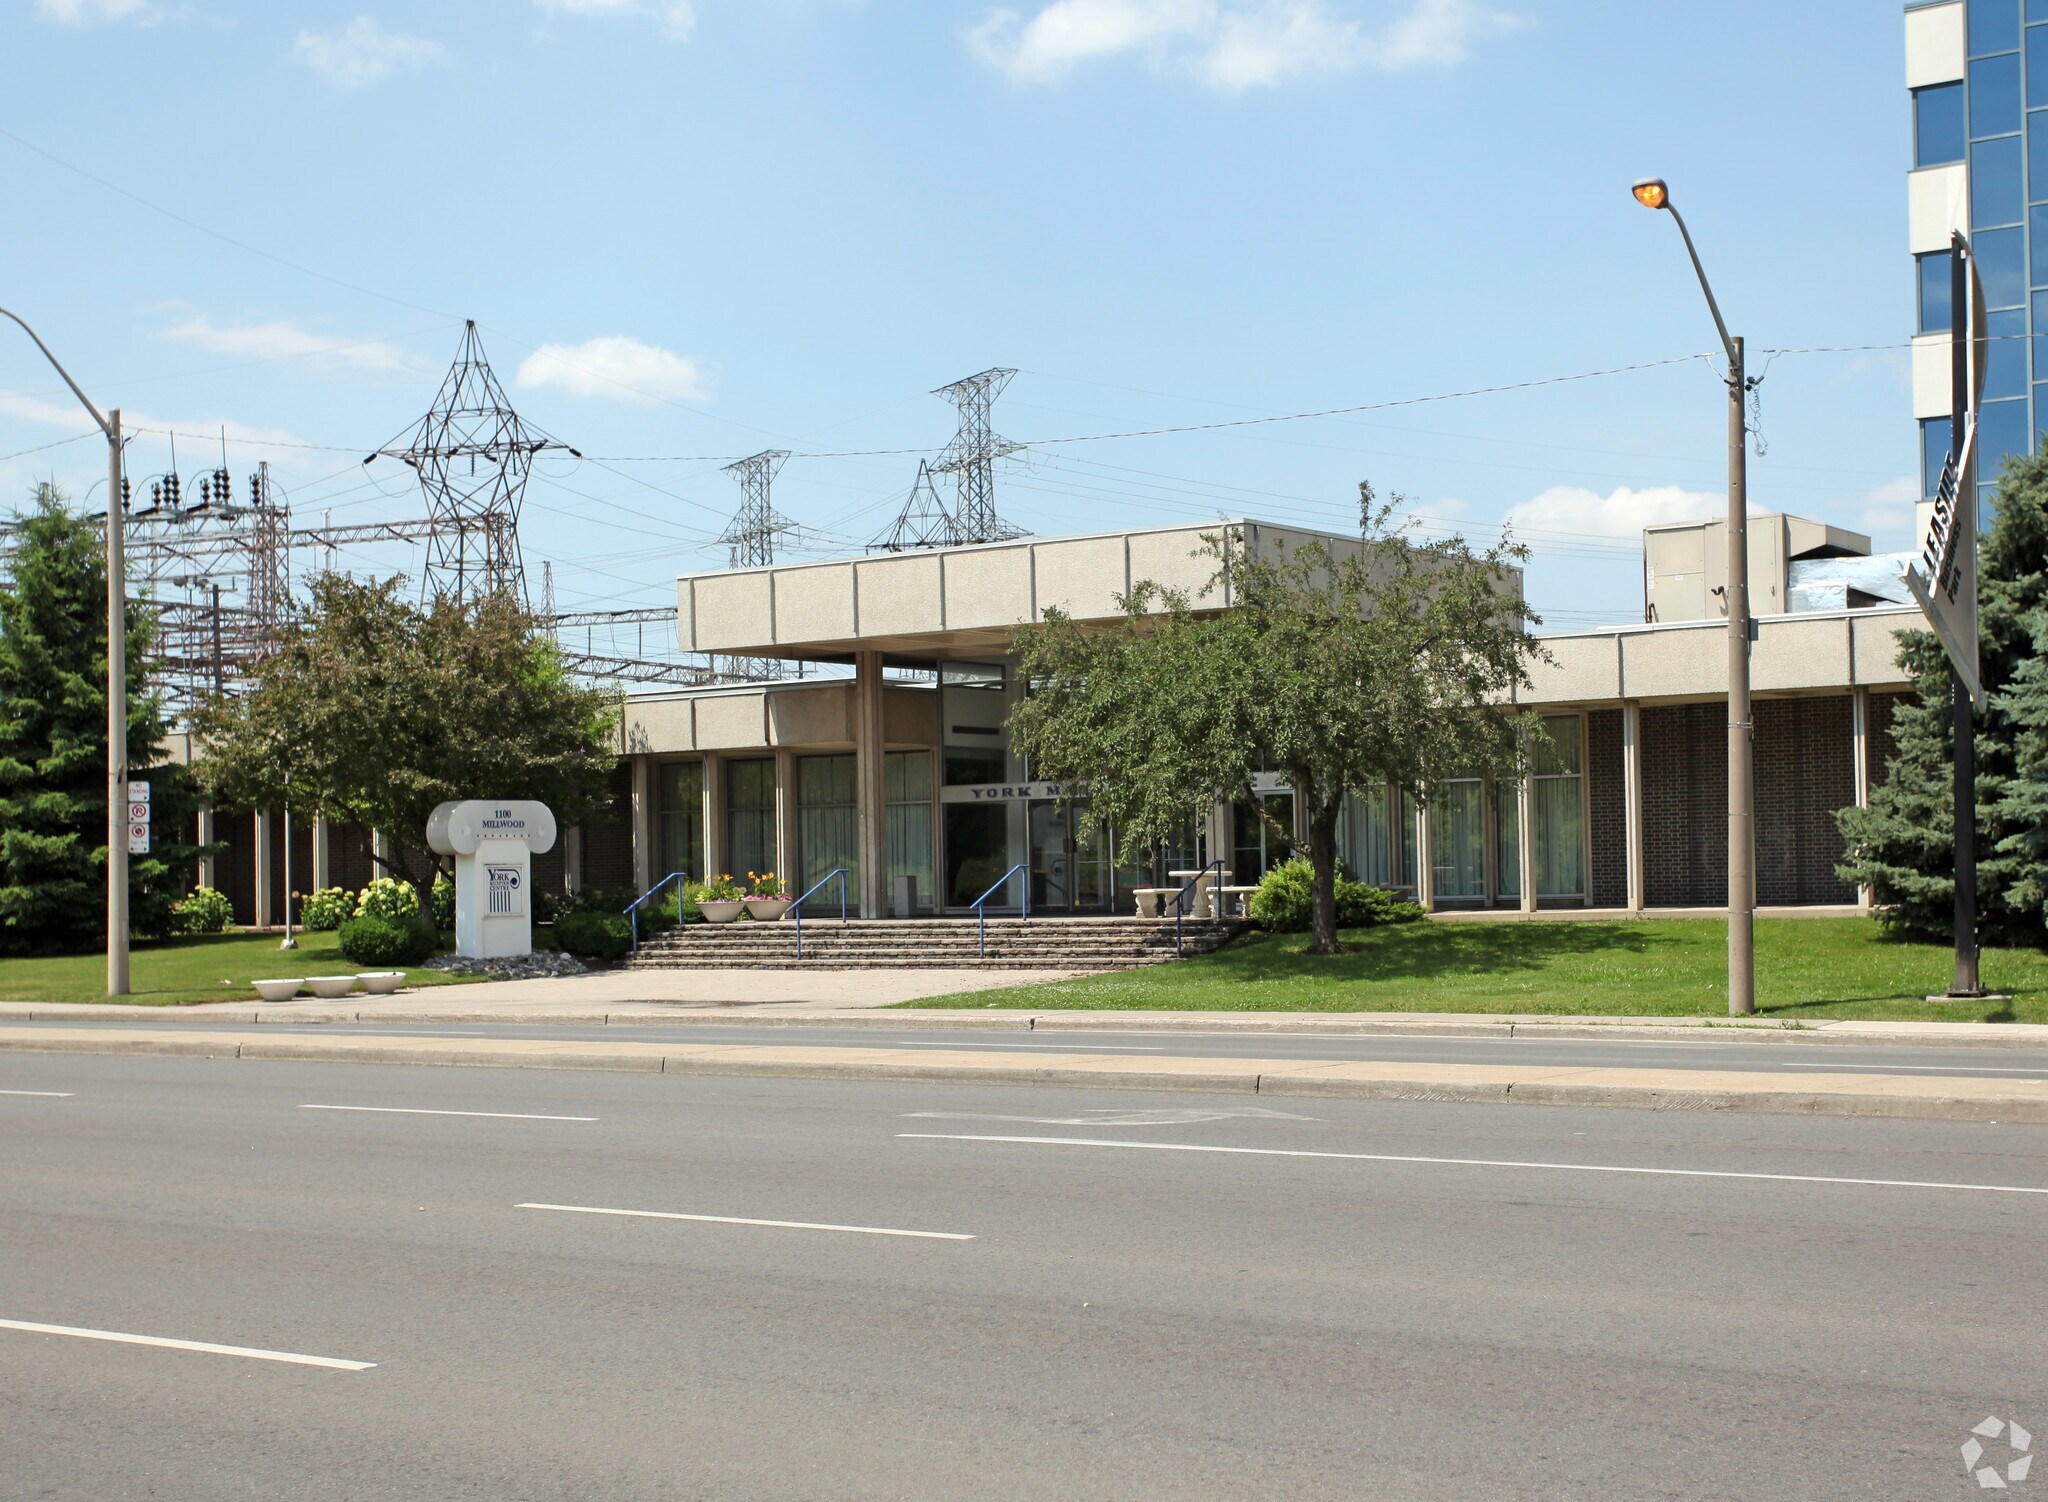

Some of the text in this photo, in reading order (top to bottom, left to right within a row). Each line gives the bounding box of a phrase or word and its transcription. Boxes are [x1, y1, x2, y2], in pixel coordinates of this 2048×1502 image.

[1946, 565, 1963, 606] Park
[970, 786, 1031, 799] YORK
[495, 809, 512, 818] 1100
[482, 820, 525, 828] MILLWOOD
